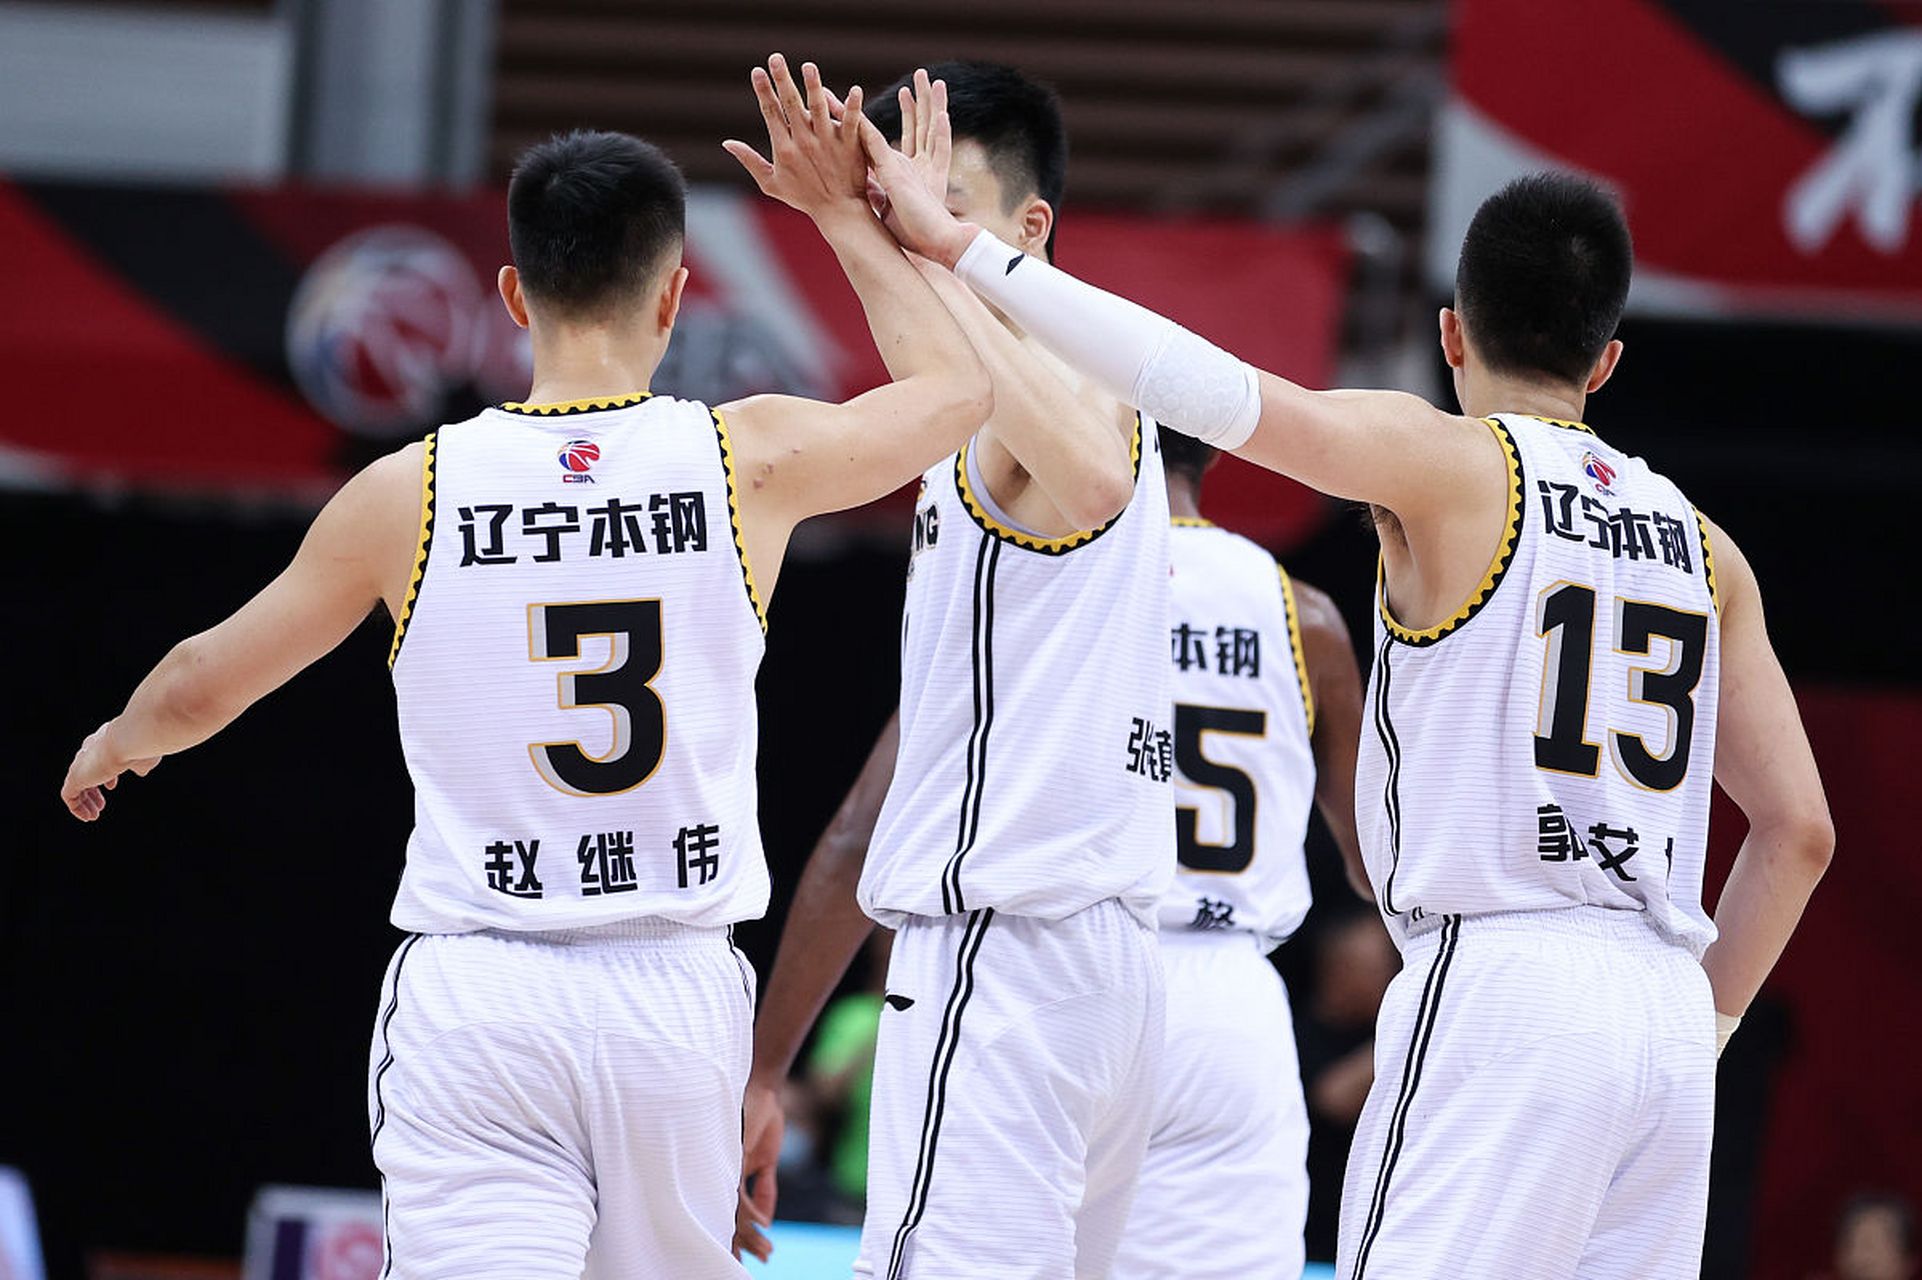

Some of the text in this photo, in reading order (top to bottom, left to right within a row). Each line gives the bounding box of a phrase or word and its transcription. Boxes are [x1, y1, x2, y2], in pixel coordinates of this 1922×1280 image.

[562, 474, 595, 484] CBA
[457, 491, 709, 568] 辽宁本钢
[1537, 479, 1694, 575] 辽宁本钢
[1171, 622, 1260, 679] 本钢
[1532, 579, 1708, 792] 13
[527, 598, 667, 797] 3
[484, 823, 720, 899] 赵继伟
[1536, 803, 1674, 892] 郭艾
